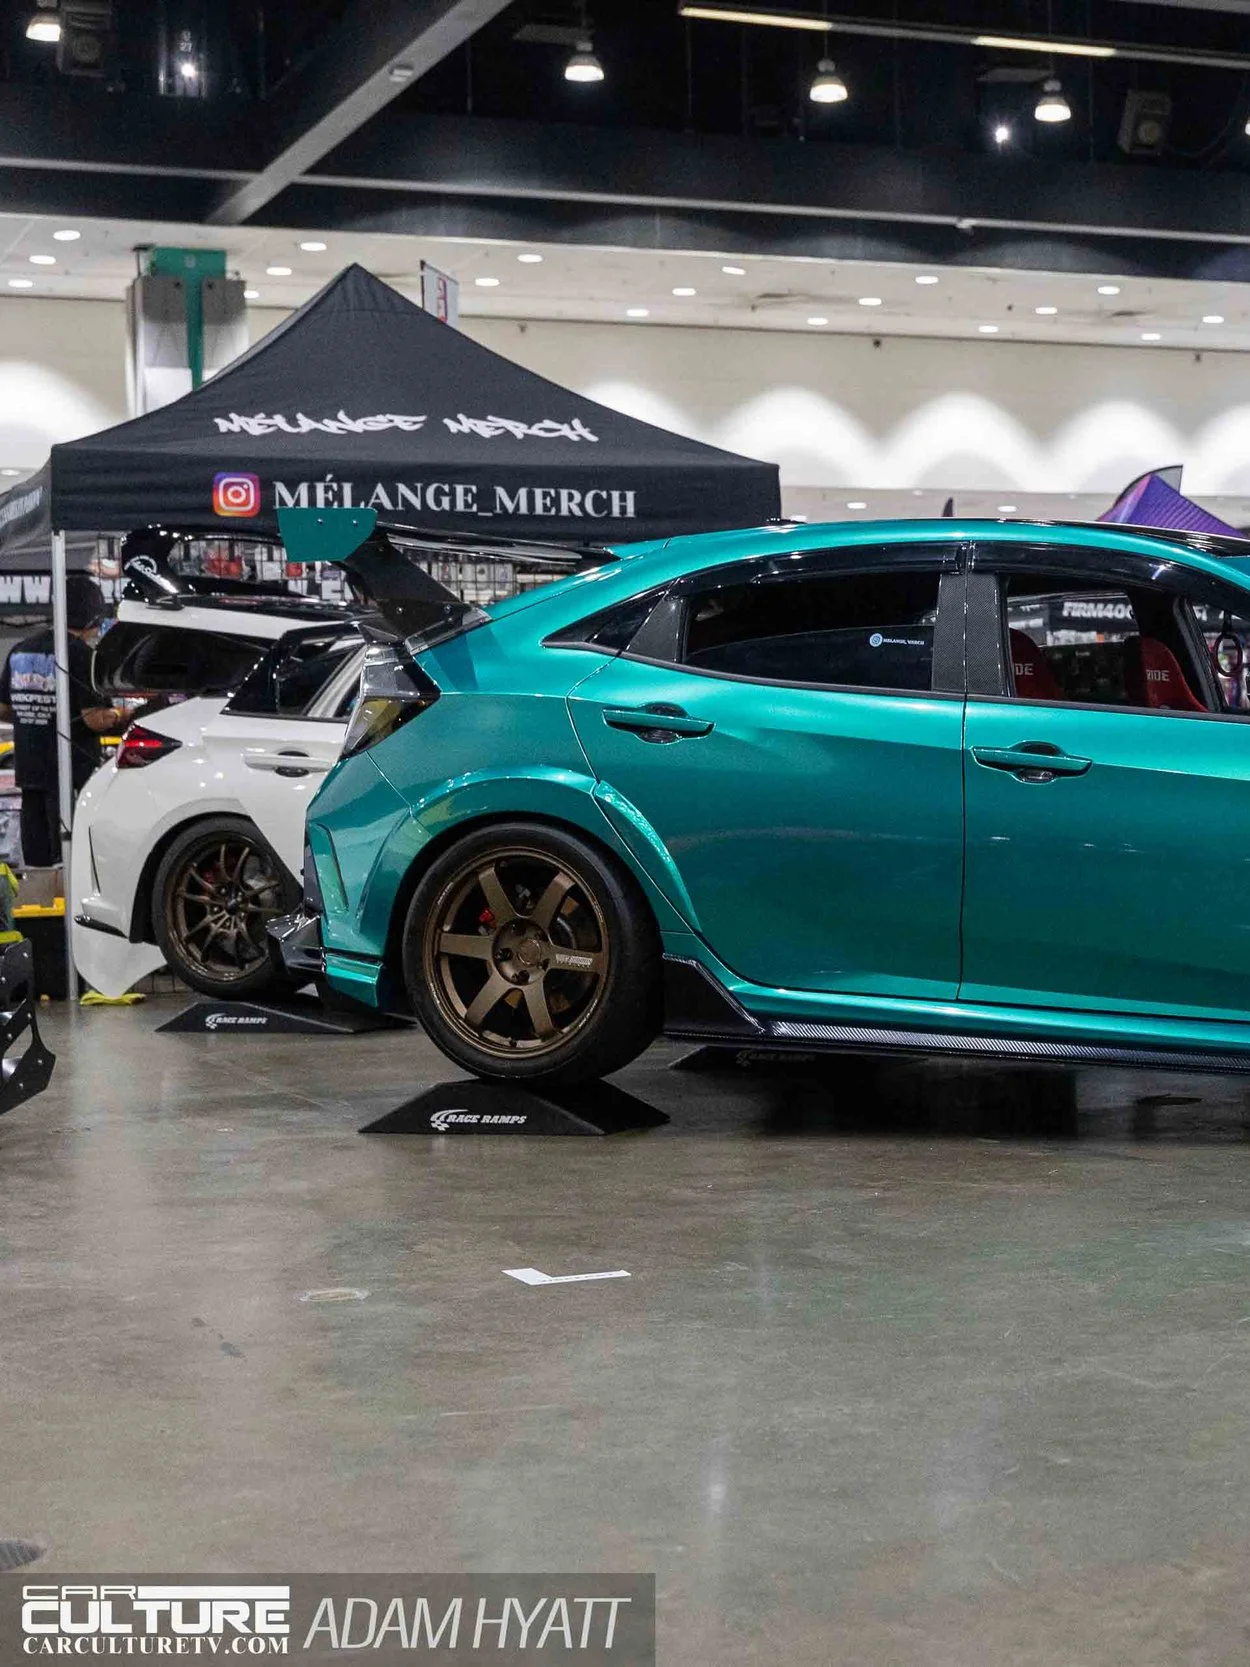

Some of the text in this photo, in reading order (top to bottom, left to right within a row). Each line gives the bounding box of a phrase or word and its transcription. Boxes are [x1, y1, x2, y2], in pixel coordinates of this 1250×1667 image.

[443, 413, 599, 442] MERCH
[273, 474, 637, 519] MÉLANGE_MERCH
[446, 1114, 527, 1124] RACE RAMPS
